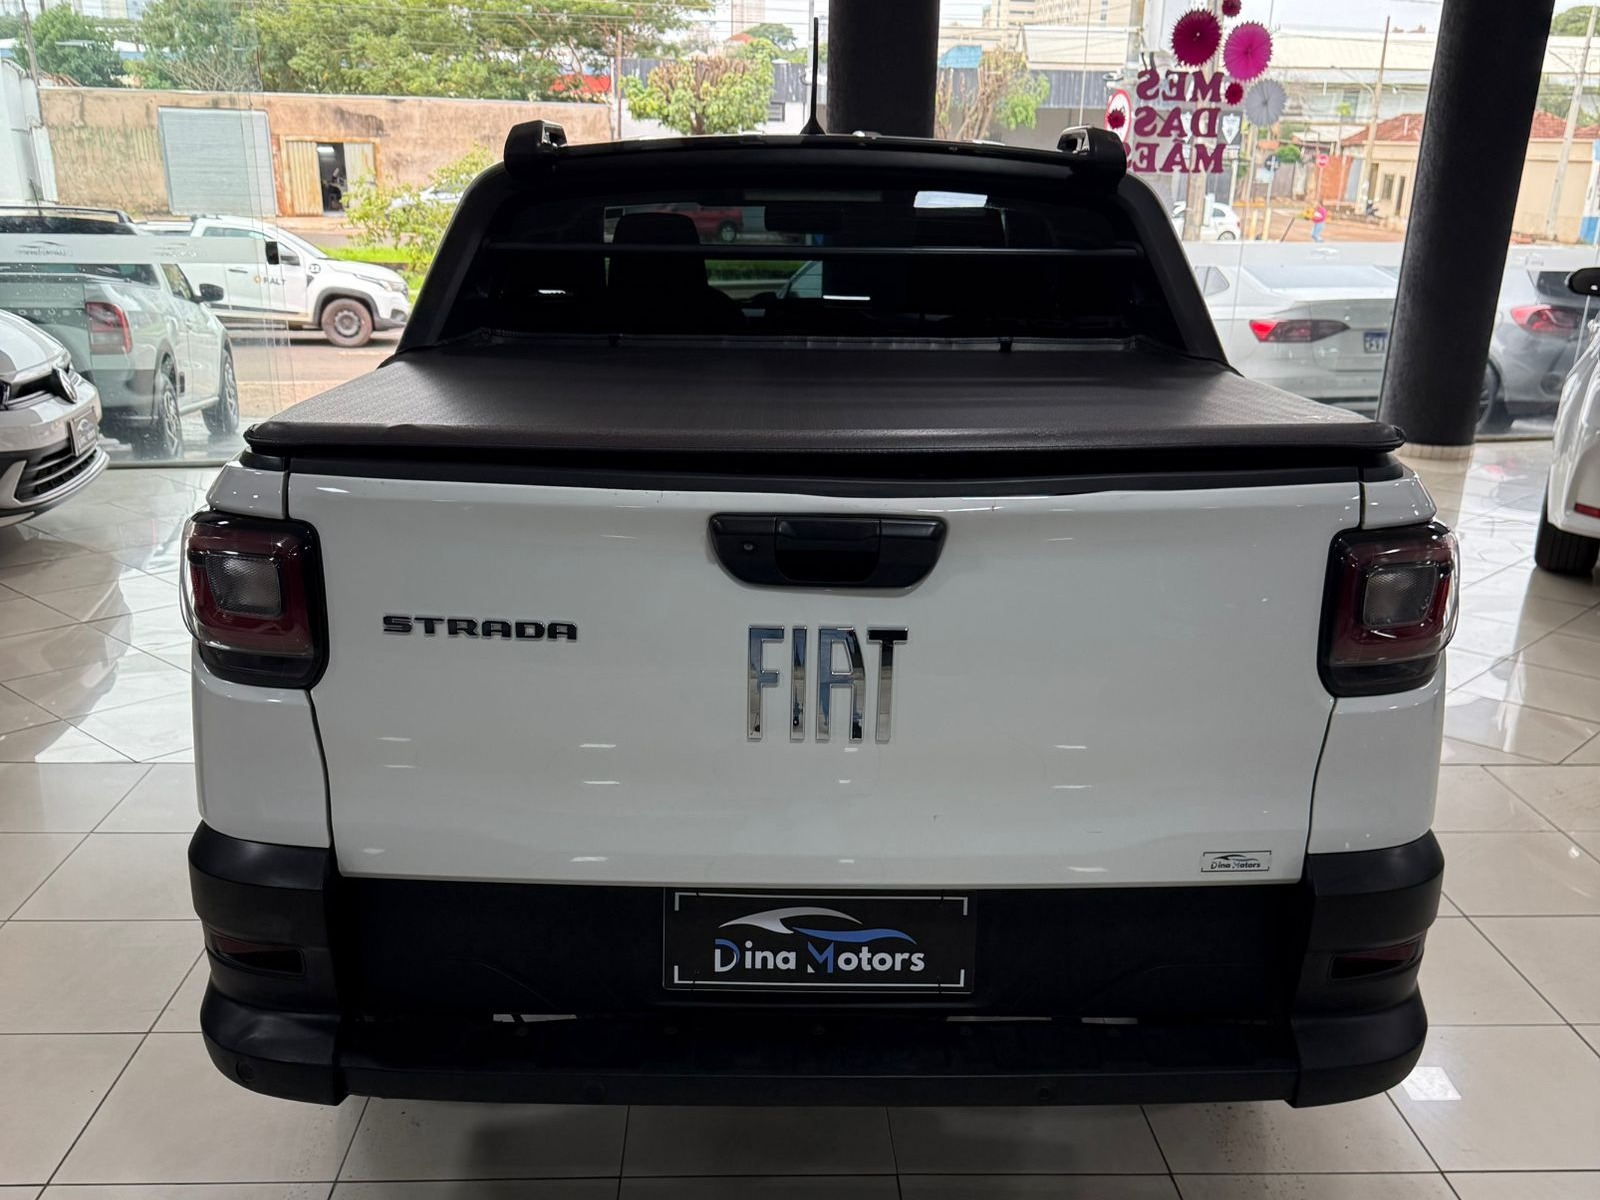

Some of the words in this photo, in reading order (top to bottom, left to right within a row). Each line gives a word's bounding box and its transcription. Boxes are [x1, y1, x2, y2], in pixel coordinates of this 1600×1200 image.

[382, 614, 578, 642] STRADA
[747, 625, 909, 743] FIAT
[1210, 861, 1231, 869] Dina
[714, 938, 796, 973] Dina
[807, 941, 926, 973] Motors
